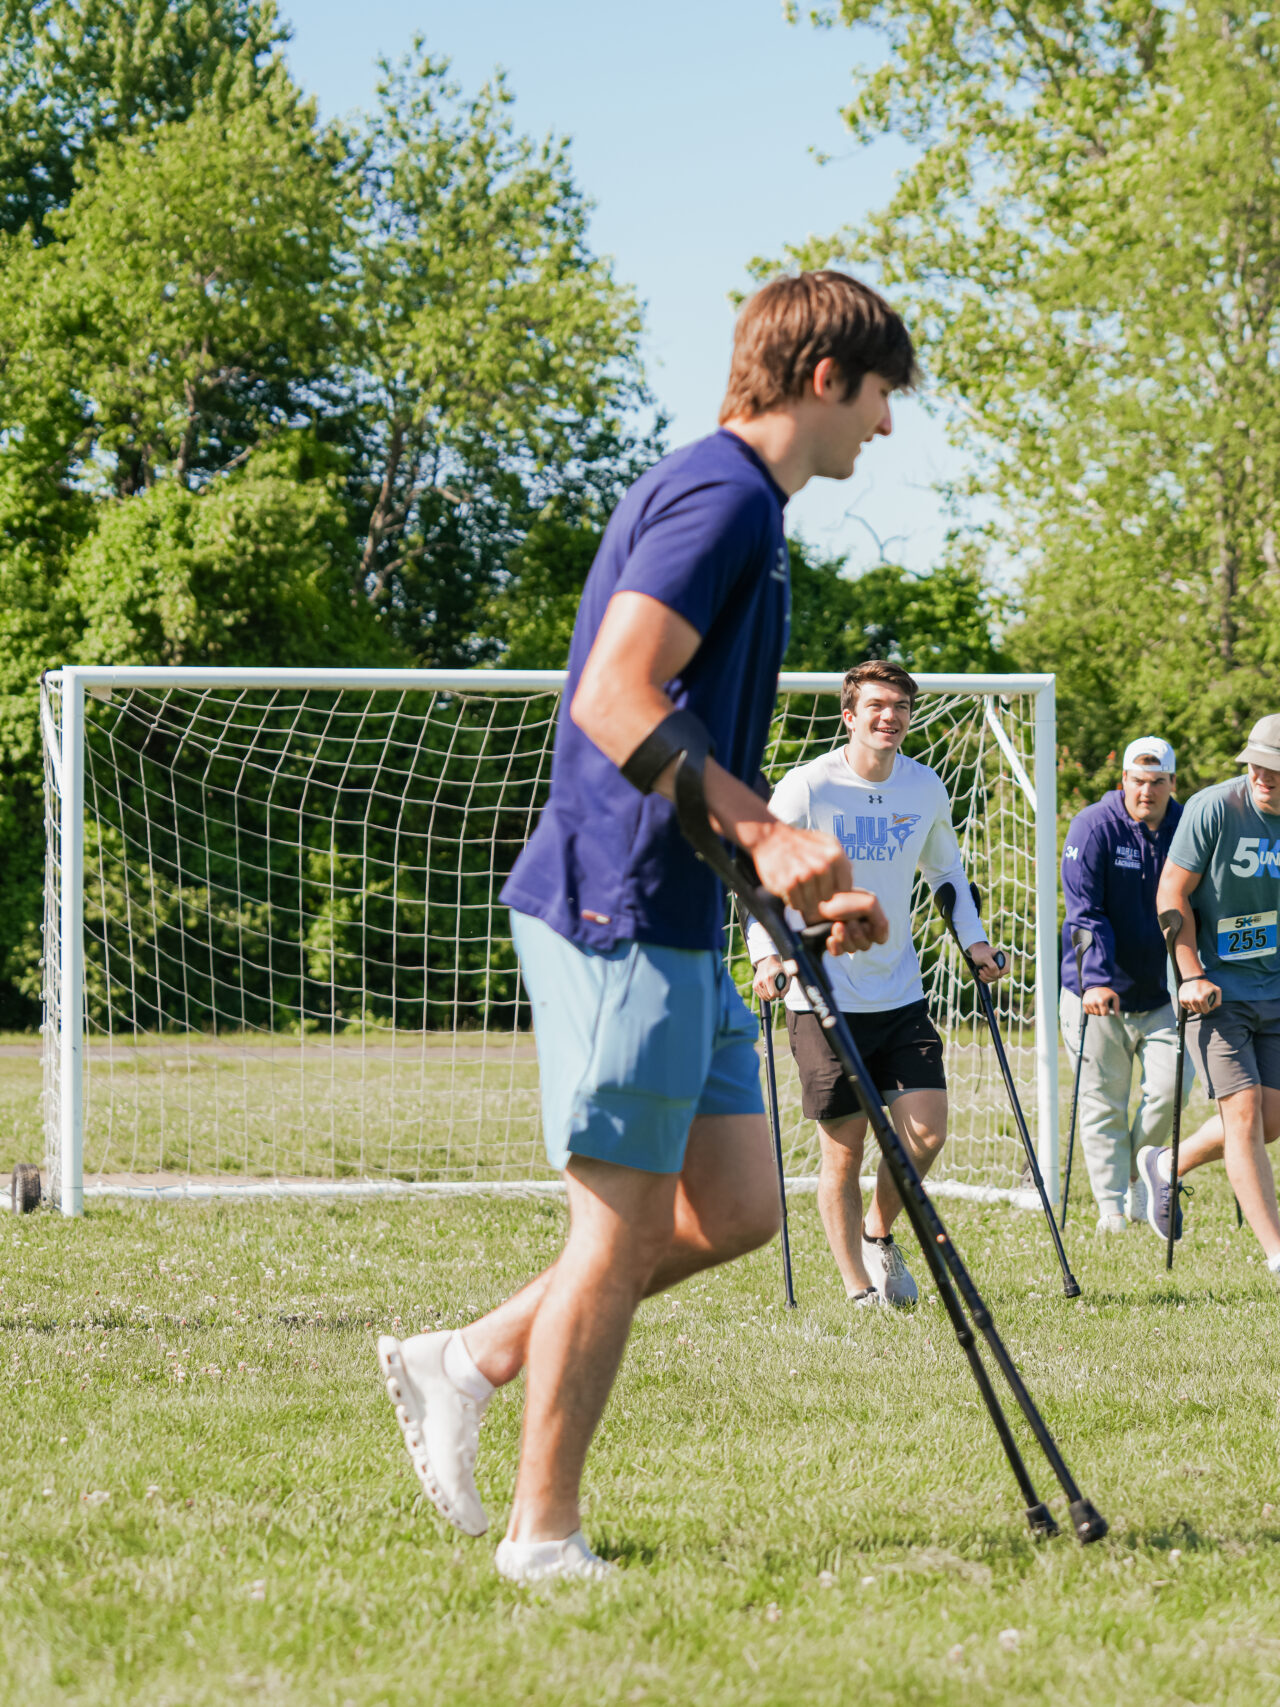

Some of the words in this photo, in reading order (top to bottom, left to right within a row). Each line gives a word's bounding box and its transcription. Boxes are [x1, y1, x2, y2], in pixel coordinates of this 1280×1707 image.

[833, 815, 888, 846] LIU
[841, 845, 896, 861] OCKEY
[1065, 845, 1079, 860] 34
[1235, 916, 1252, 928] 5K
[1229, 928, 1267, 952] 255
